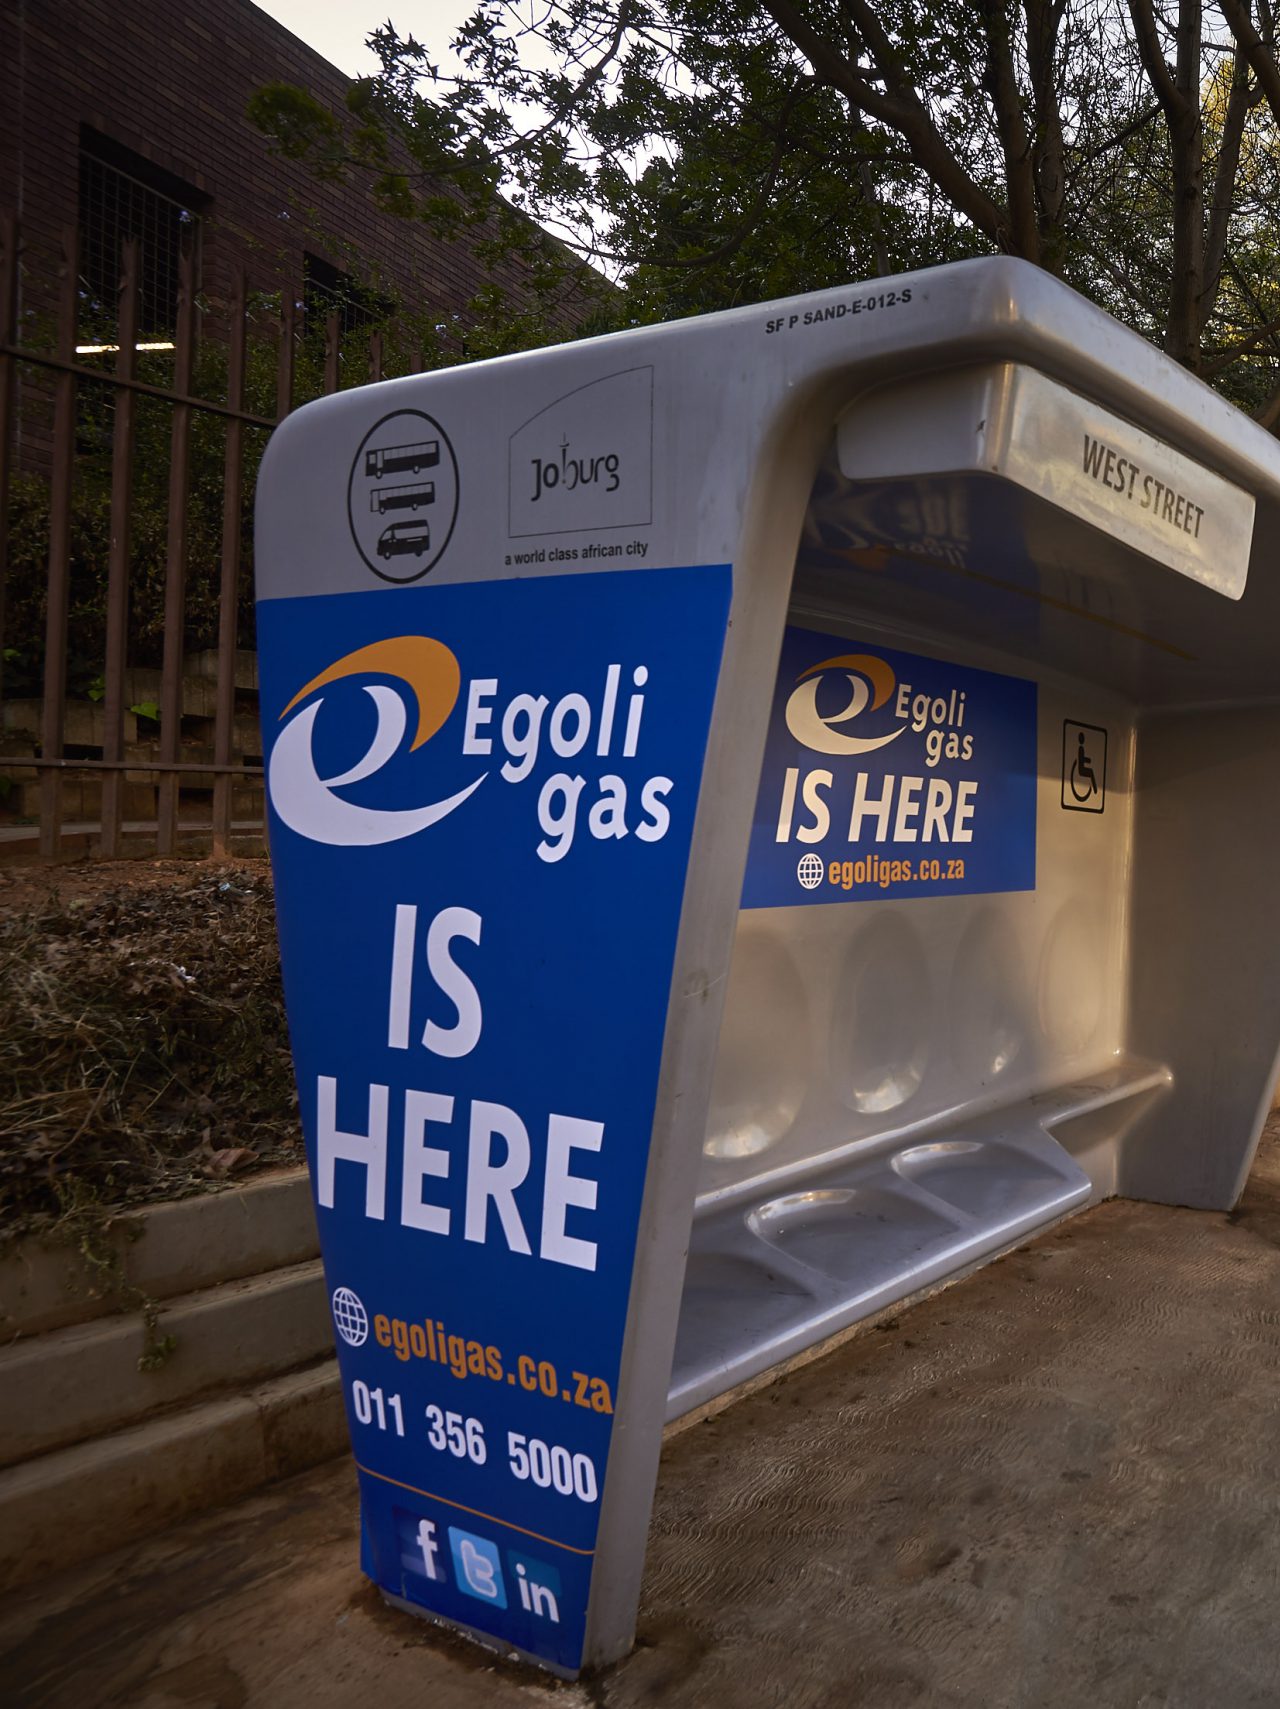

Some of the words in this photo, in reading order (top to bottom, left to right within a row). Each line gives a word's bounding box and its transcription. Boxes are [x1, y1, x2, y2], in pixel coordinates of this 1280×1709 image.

[765, 318, 784, 334] SF
[789, 315, 799, 329] P
[805, 288, 912, 326] SAND-E-012-S
[1083, 434, 1139, 500] WEST
[1140, 475, 1204, 539] STREET
[505, 554, 512, 566] a
[515, 549, 546, 565] world
[548, 547, 579, 562] class
[582, 544, 623, 559] african
[626, 540, 649, 557] city
[462, 664, 648, 783] Egoli
[895, 683, 966, 732] Egoli
[925, 729, 974, 768] gas
[536, 773, 675, 863] gas
[775, 767, 834, 844] IS
[847, 772, 979, 843] HERE
[828, 854, 965, 890] egoligas.co.za
[388, 903, 483, 1058] IS
[317, 1075, 605, 1271] HERE
[373, 1312, 614, 1415] egoligas.co.za
[352, 1379, 405, 1437] 011
[425, 1404, 487, 1465] 356
[507, 1431, 598, 1503] 5000
